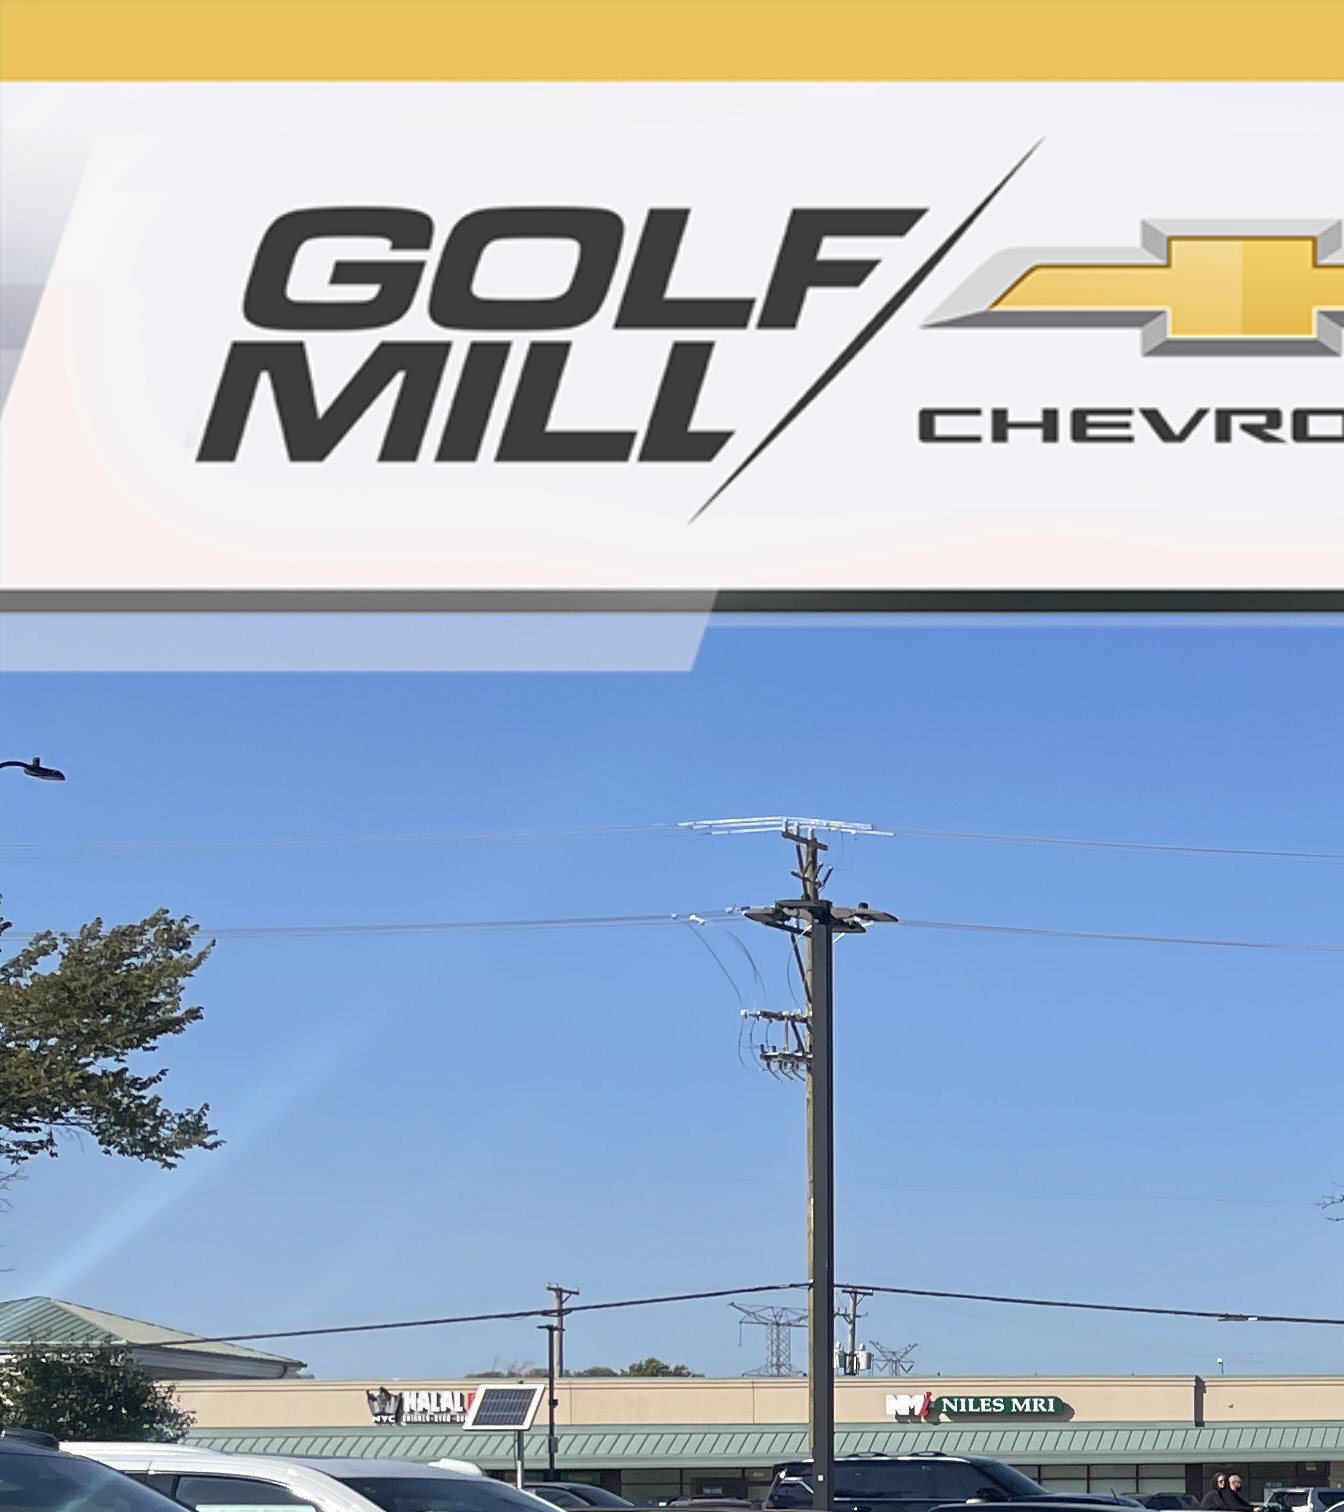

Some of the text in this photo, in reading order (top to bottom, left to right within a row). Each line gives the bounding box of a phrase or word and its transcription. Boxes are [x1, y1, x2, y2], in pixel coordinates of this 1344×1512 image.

[403, 1391, 465, 1412] HALAL
[942, 1398, 1055, 1412] NILES MRI
